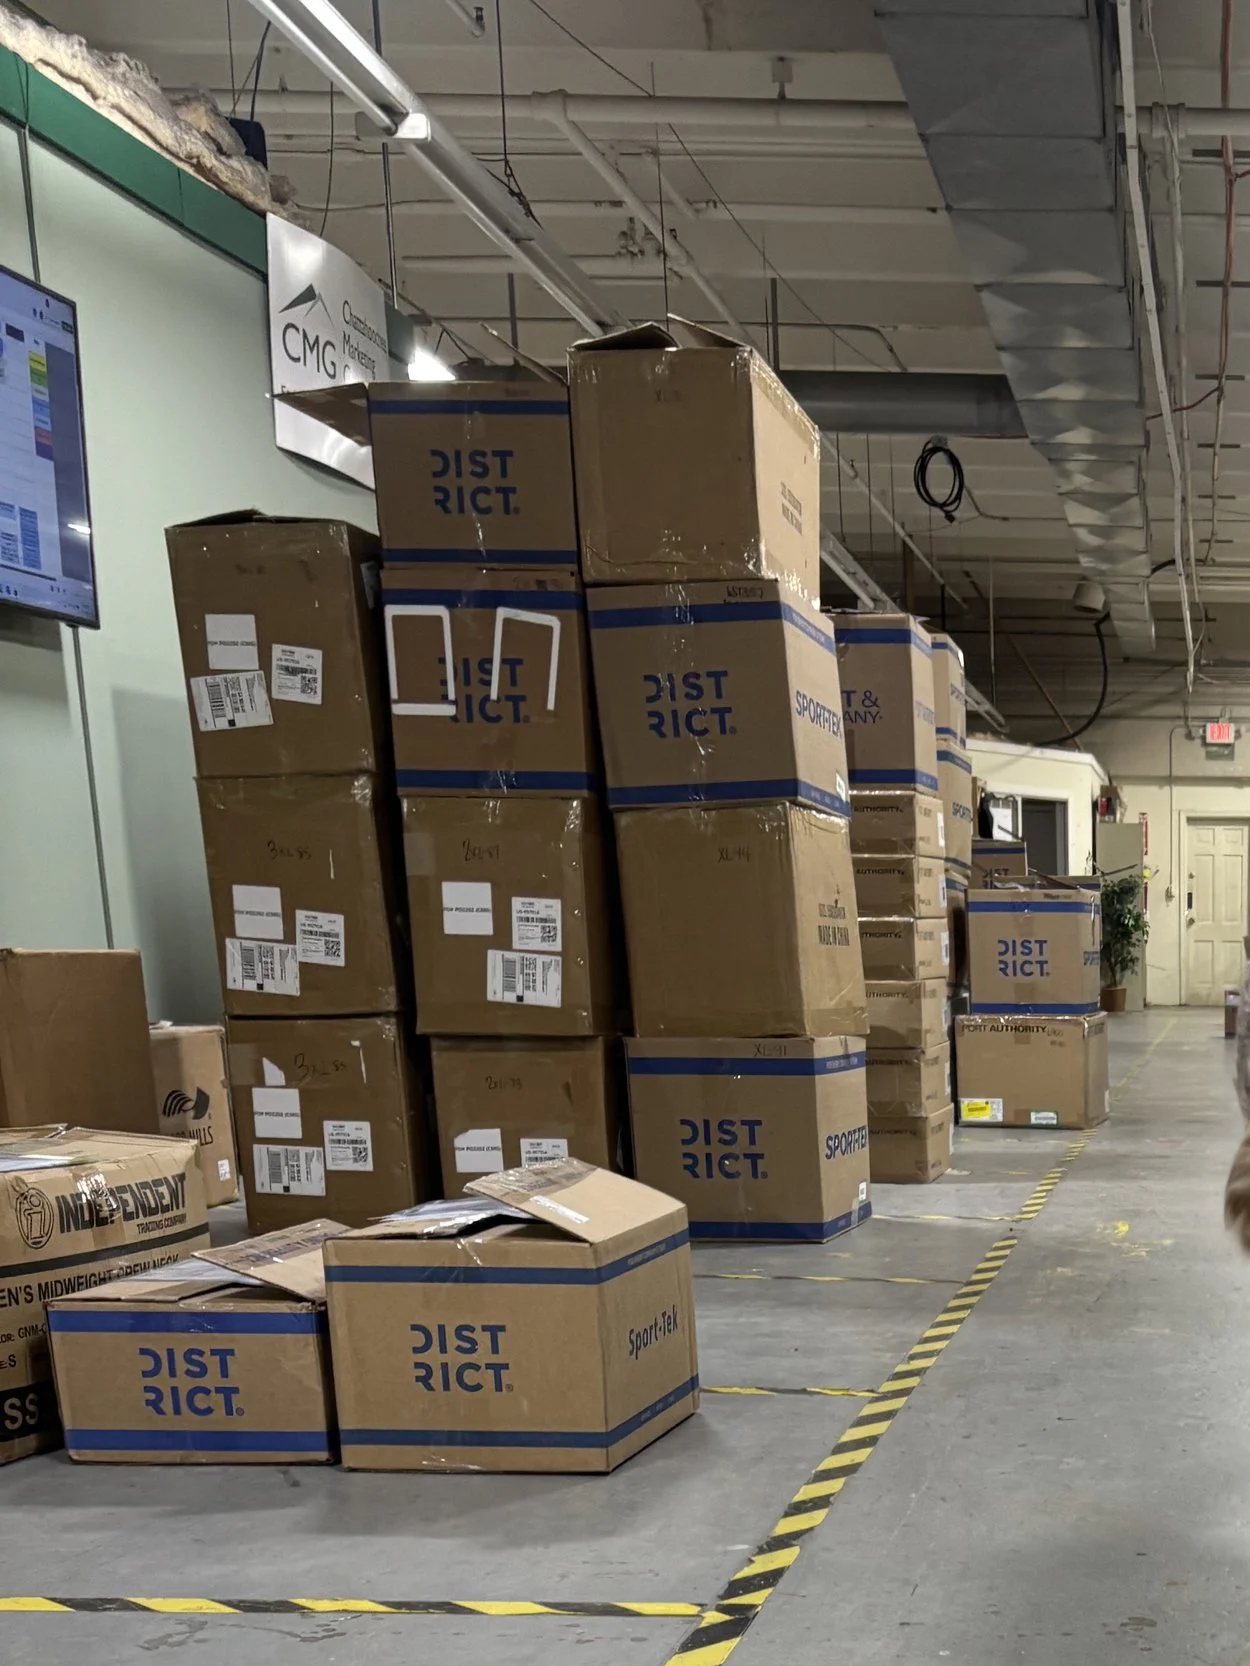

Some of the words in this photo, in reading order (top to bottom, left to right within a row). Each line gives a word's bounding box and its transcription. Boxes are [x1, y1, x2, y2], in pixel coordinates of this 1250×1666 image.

[282, 322, 336, 380] CMG
[430, 449, 514, 480] DIST
[438, 657, 524, 688] DIST
[643, 670, 728, 703] DIST
[1209, 723, 1229, 741] EXIT
[997, 939, 1048, 957] DIST
[962, 1024, 987, 1033] PORT
[989, 1024, 1048, 1033] AUTHORITY
[680, 1119, 763, 1146] DIST
[55, 1172, 186, 1234] INDEPENDENT
[137, 1219, 164, 1235] TRADING
[164, 1213, 187, 1232] COMPANY
[410, 1324, 506, 1355] DIST
[628, 1304, 678, 1360] Sport-Tek
[139, 1347, 235, 1378] DIST
